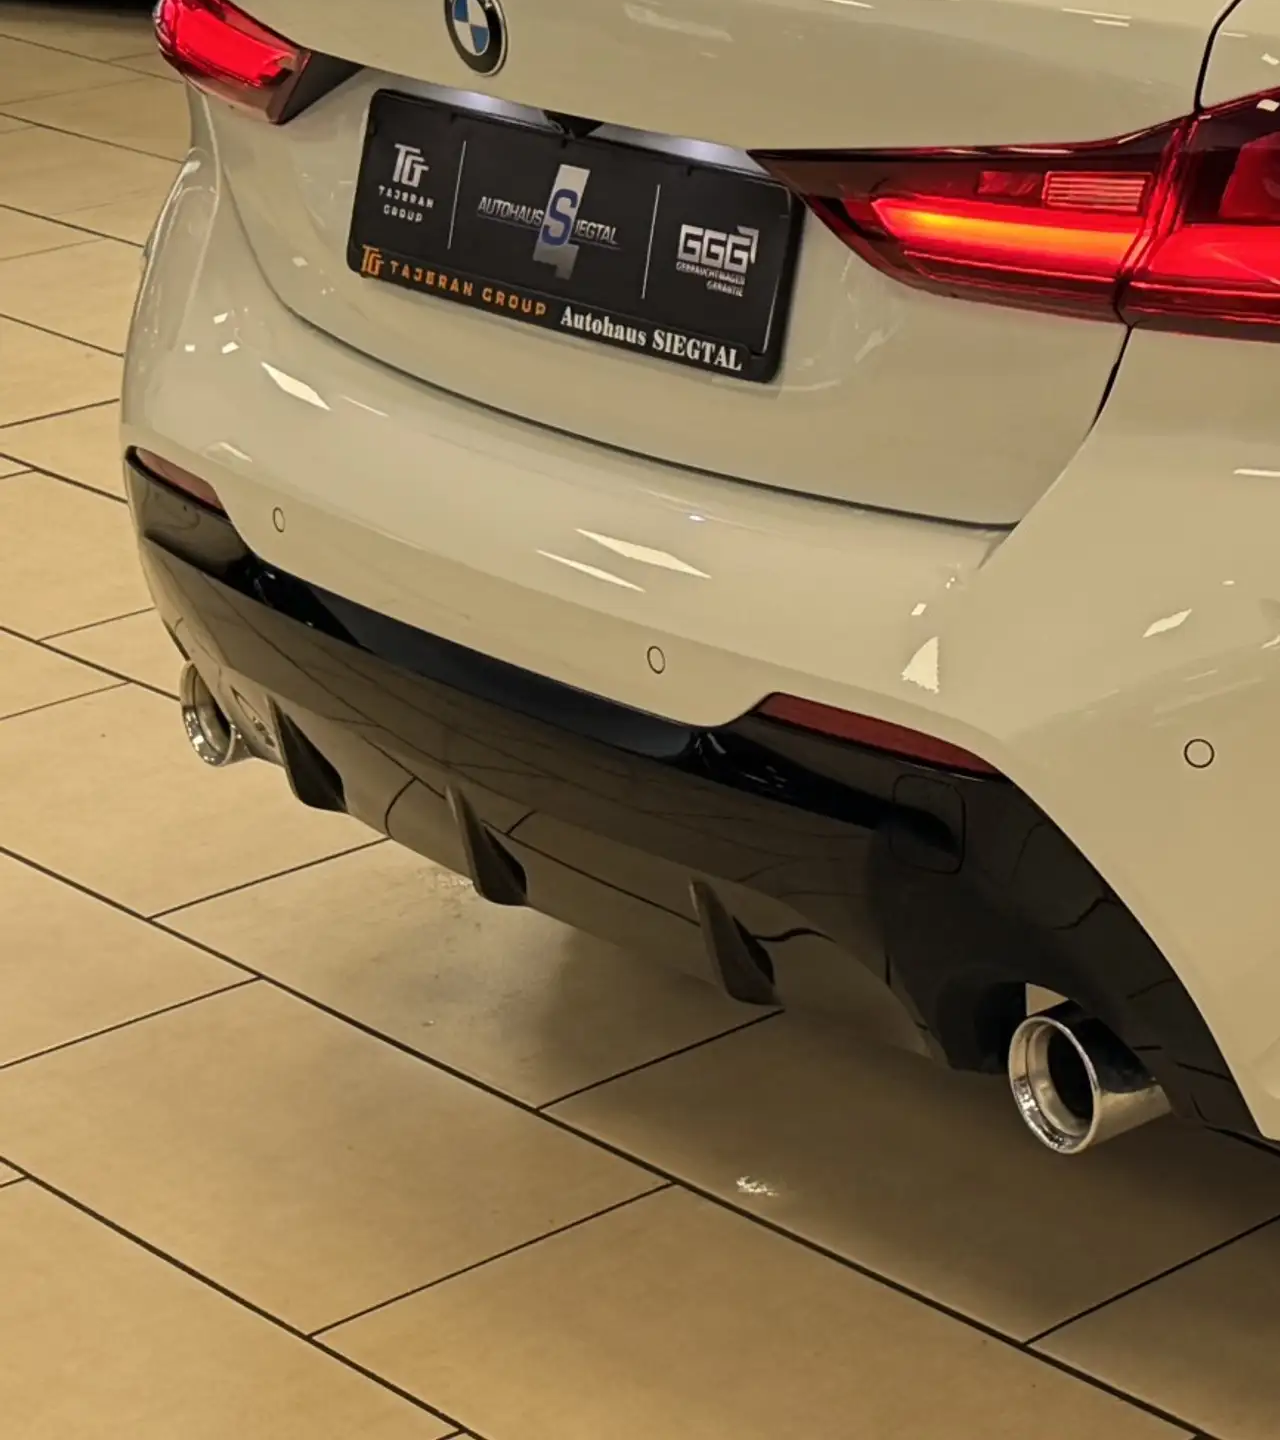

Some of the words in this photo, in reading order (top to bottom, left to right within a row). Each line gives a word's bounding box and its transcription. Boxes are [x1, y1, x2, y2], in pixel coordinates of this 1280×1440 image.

[383, 203, 423, 222] GROUP
[477, 196, 545, 227] AUTOHAUS
[678, 223, 752, 274] GGG
[390, 260, 474, 297] TAJERAN
[482, 287, 546, 317] GROUP
[560, 306, 647, 347] Autohaus
[652, 328, 742, 372] SIEGTAL
